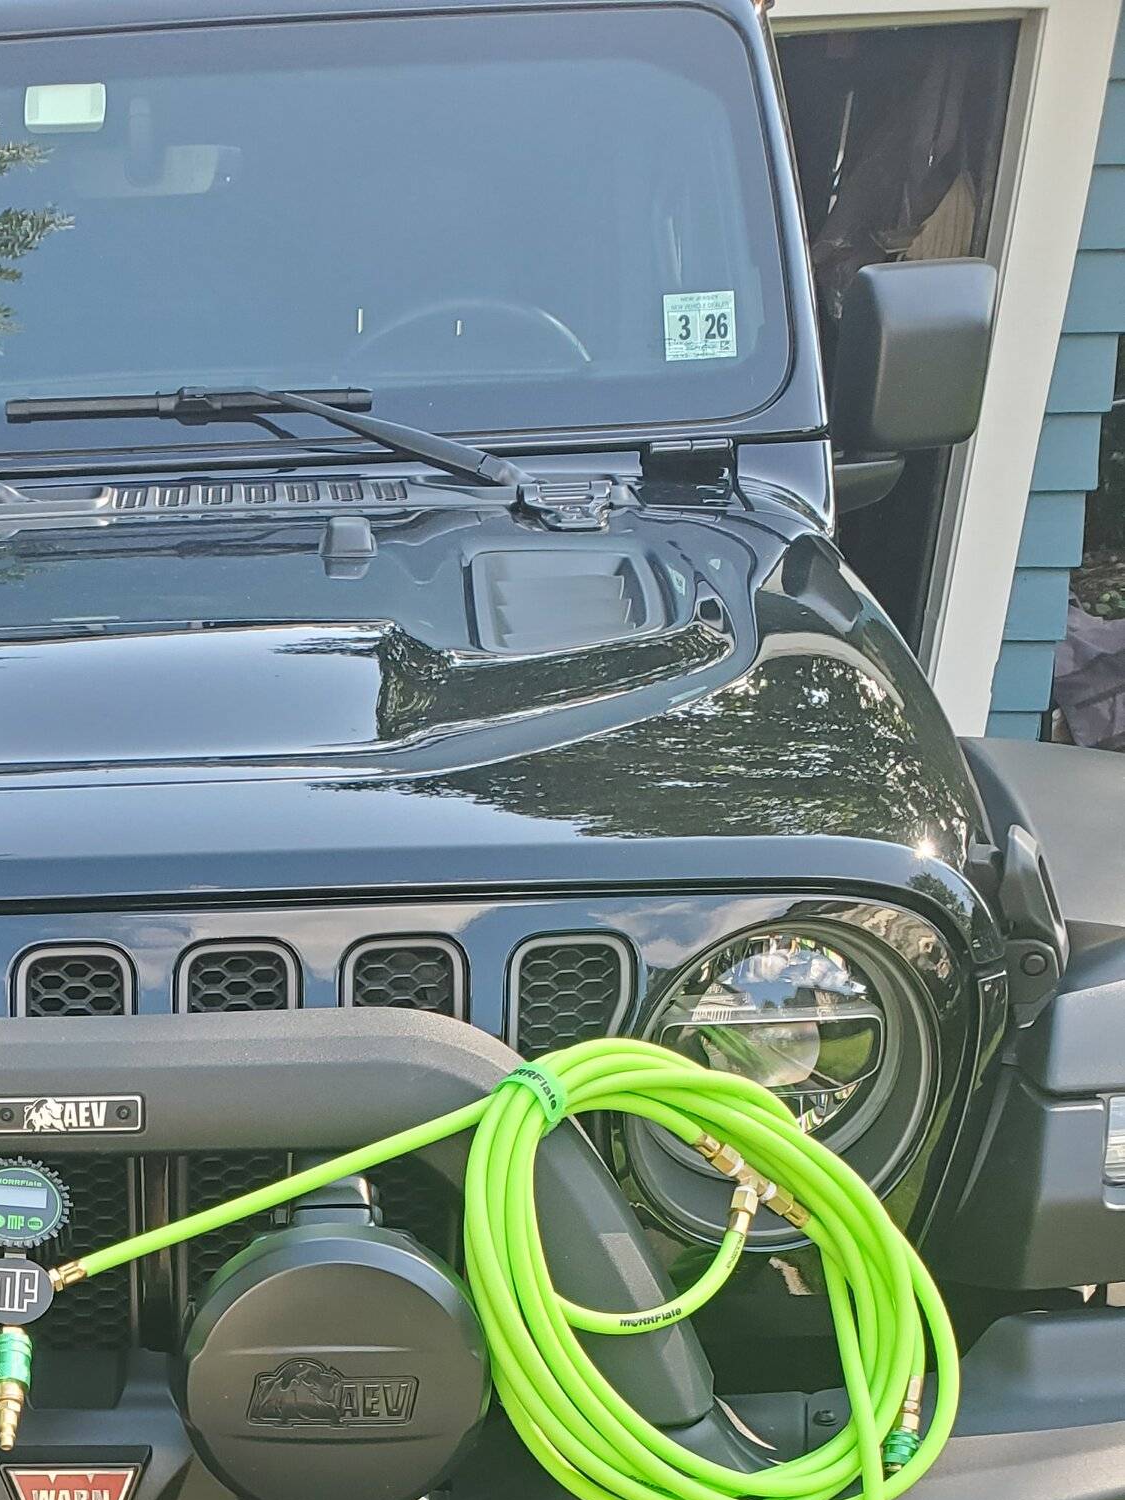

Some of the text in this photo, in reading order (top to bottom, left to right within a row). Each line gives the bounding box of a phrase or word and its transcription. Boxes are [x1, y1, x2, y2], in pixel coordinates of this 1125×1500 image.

[678, 312, 729, 341] 3 26
[63, 1101, 108, 1128] AEV
[339, 1383, 409, 1418] AEV
